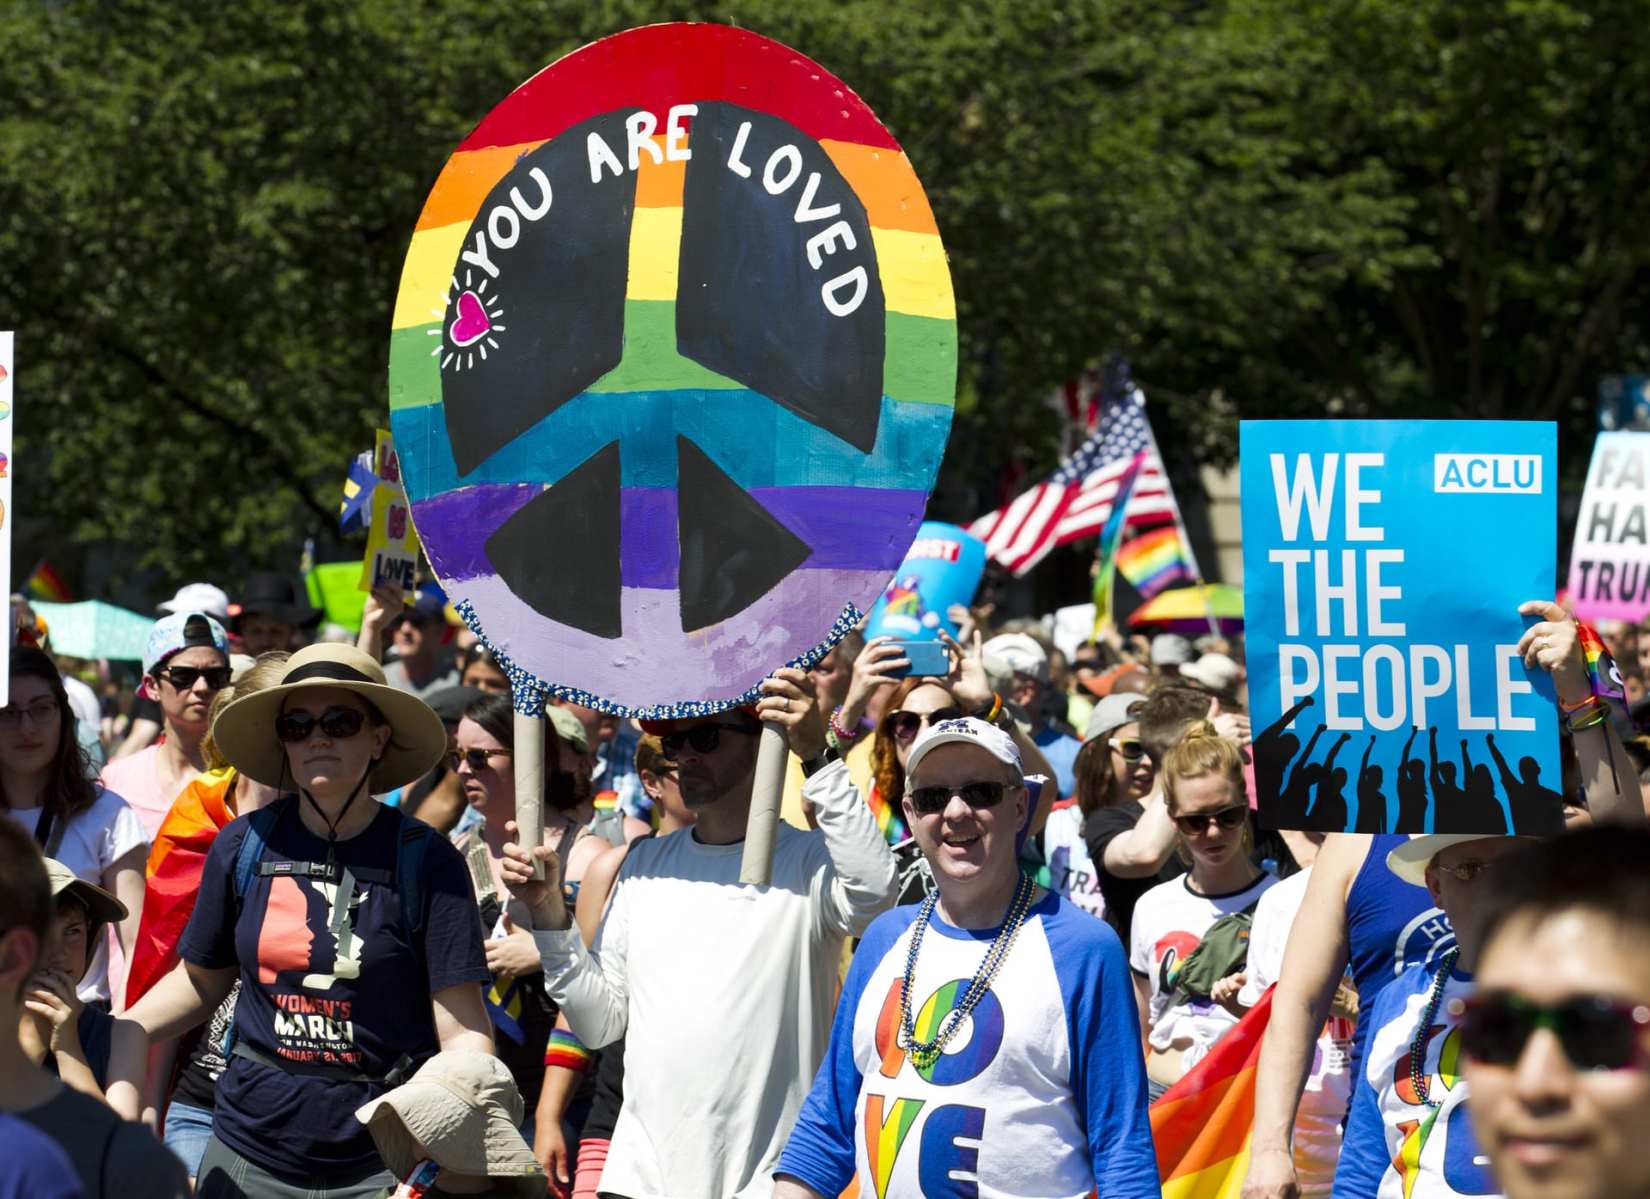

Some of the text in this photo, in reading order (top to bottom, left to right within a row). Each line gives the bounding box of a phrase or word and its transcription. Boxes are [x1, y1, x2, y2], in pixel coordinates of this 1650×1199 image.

[462, 104, 869, 317] YOU ARE LOVED
[1269, 453, 1385, 541] WE
[1440, 459, 1535, 488] ACLU
[1268, 549, 1407, 636] THE
[1278, 644, 1537, 731] PEOPLE
